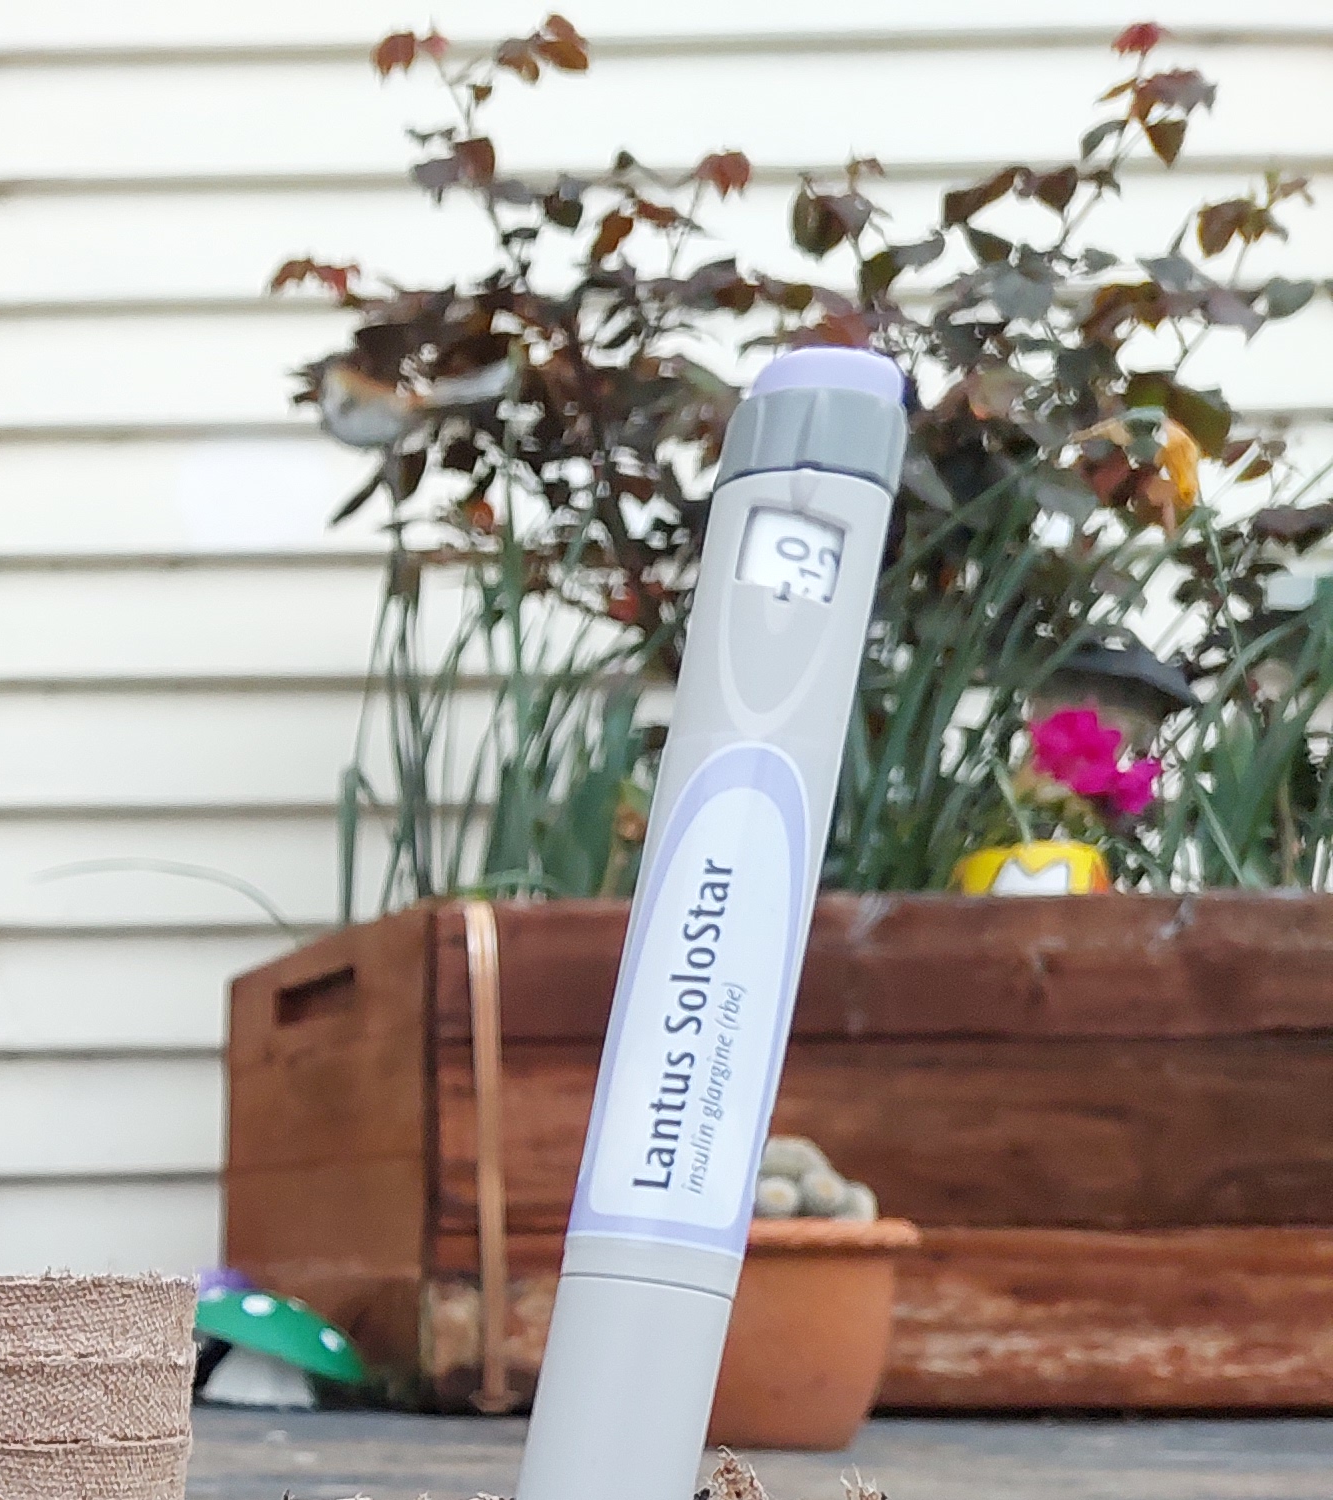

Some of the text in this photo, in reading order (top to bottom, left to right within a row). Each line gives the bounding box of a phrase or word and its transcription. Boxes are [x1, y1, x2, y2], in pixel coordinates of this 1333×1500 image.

[776, 537, 810, 560] 0
[632, 858, 732, 1191] Lantus SoloStar
[682, 981, 748, 1195] insulin glargine (rbe)
